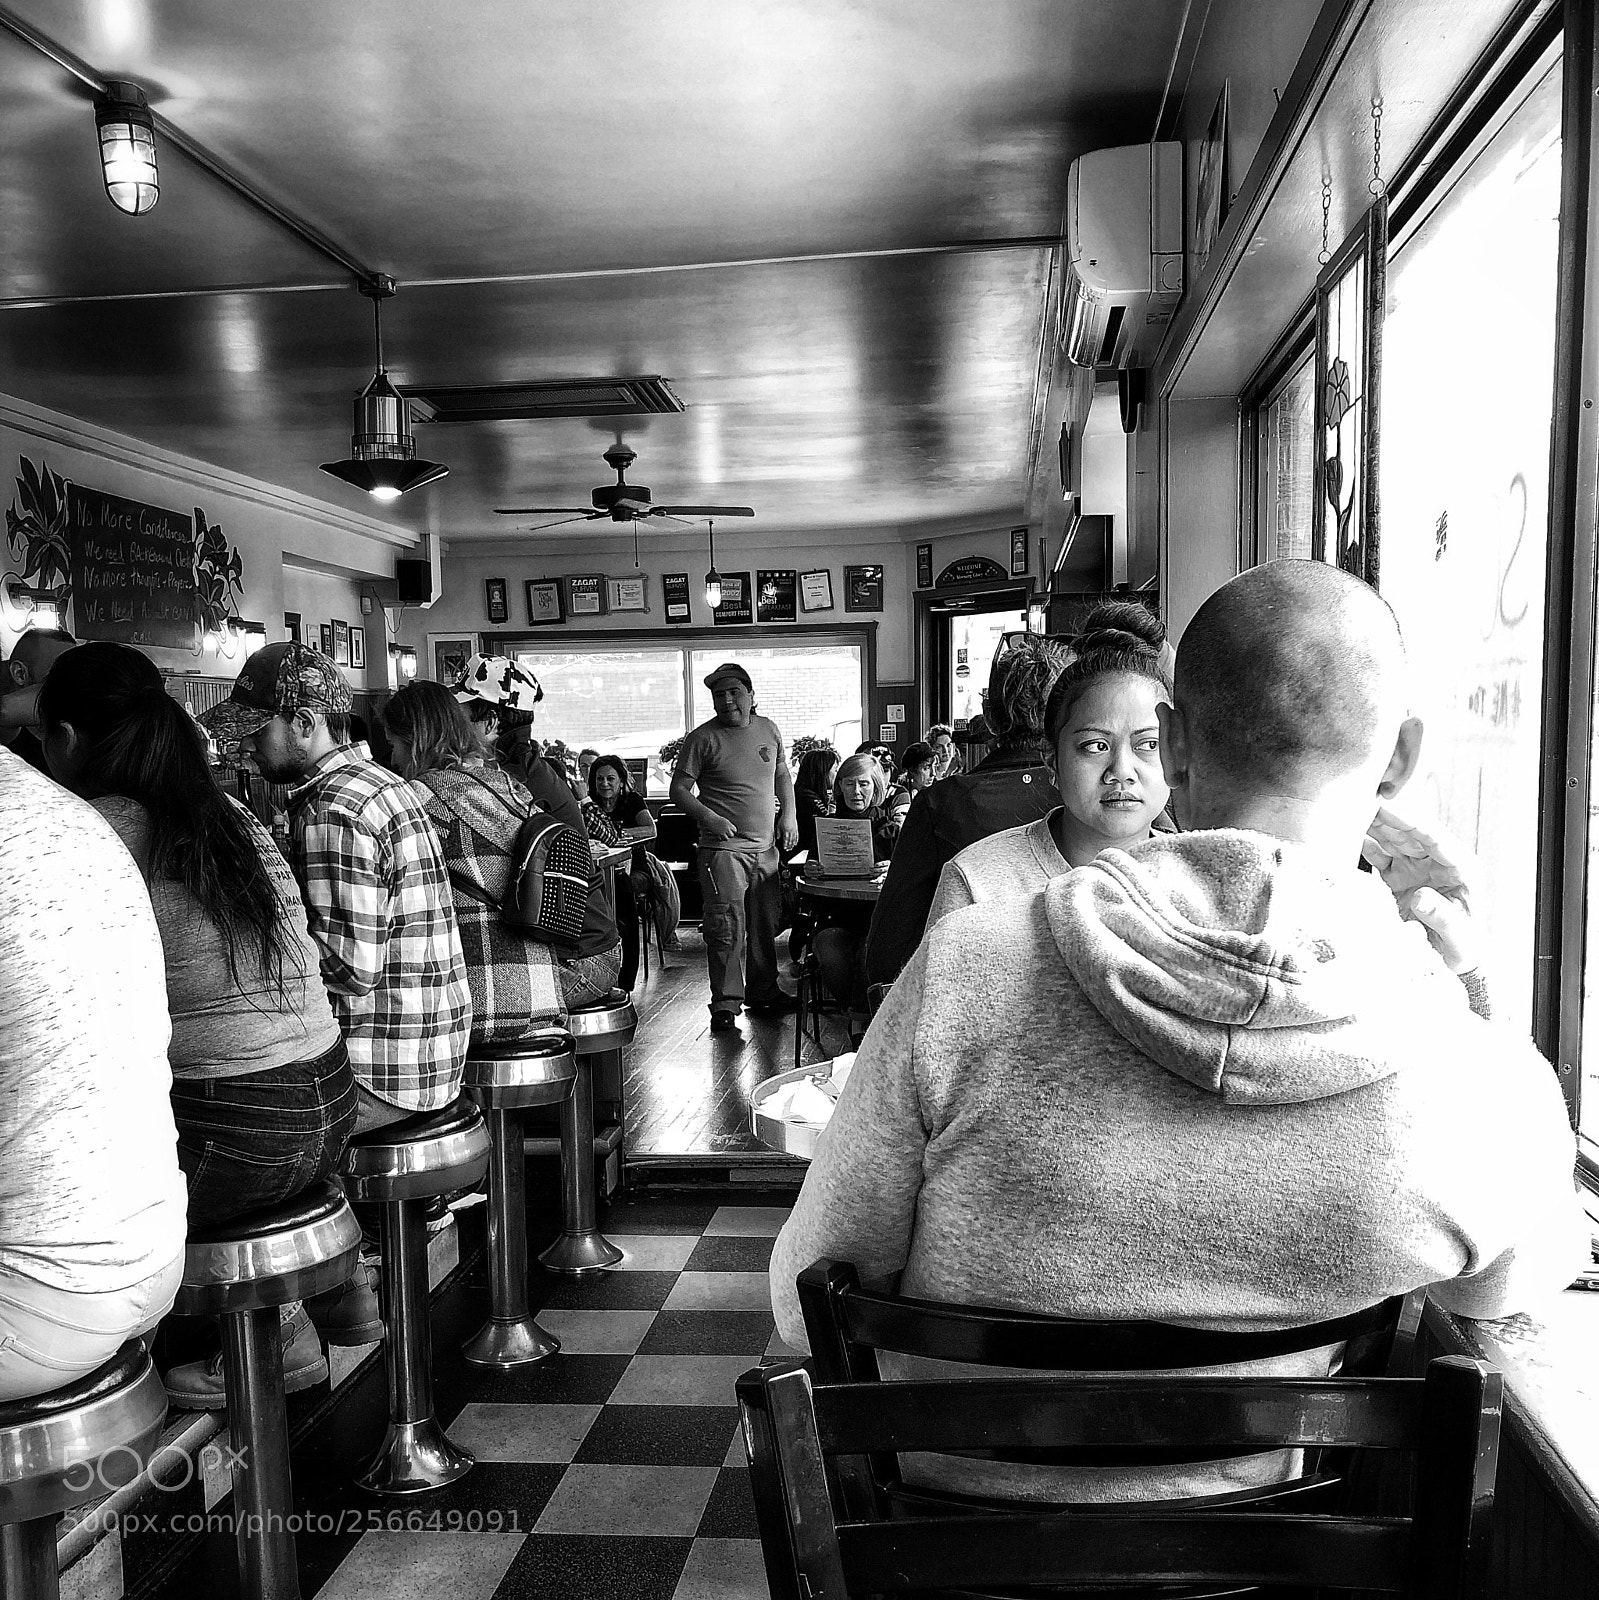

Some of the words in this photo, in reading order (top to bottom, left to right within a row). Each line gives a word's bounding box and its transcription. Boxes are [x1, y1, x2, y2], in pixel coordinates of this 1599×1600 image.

[77, 498, 93, 527] No
[101, 499, 132, 530] More
[84, 540, 102, 560] We
[84, 565, 99, 589] No
[571, 585, 599, 593] SURVEY
[722, 601, 742, 610] Best
[761, 595, 777, 605] Best
[84, 600, 105, 623] We
